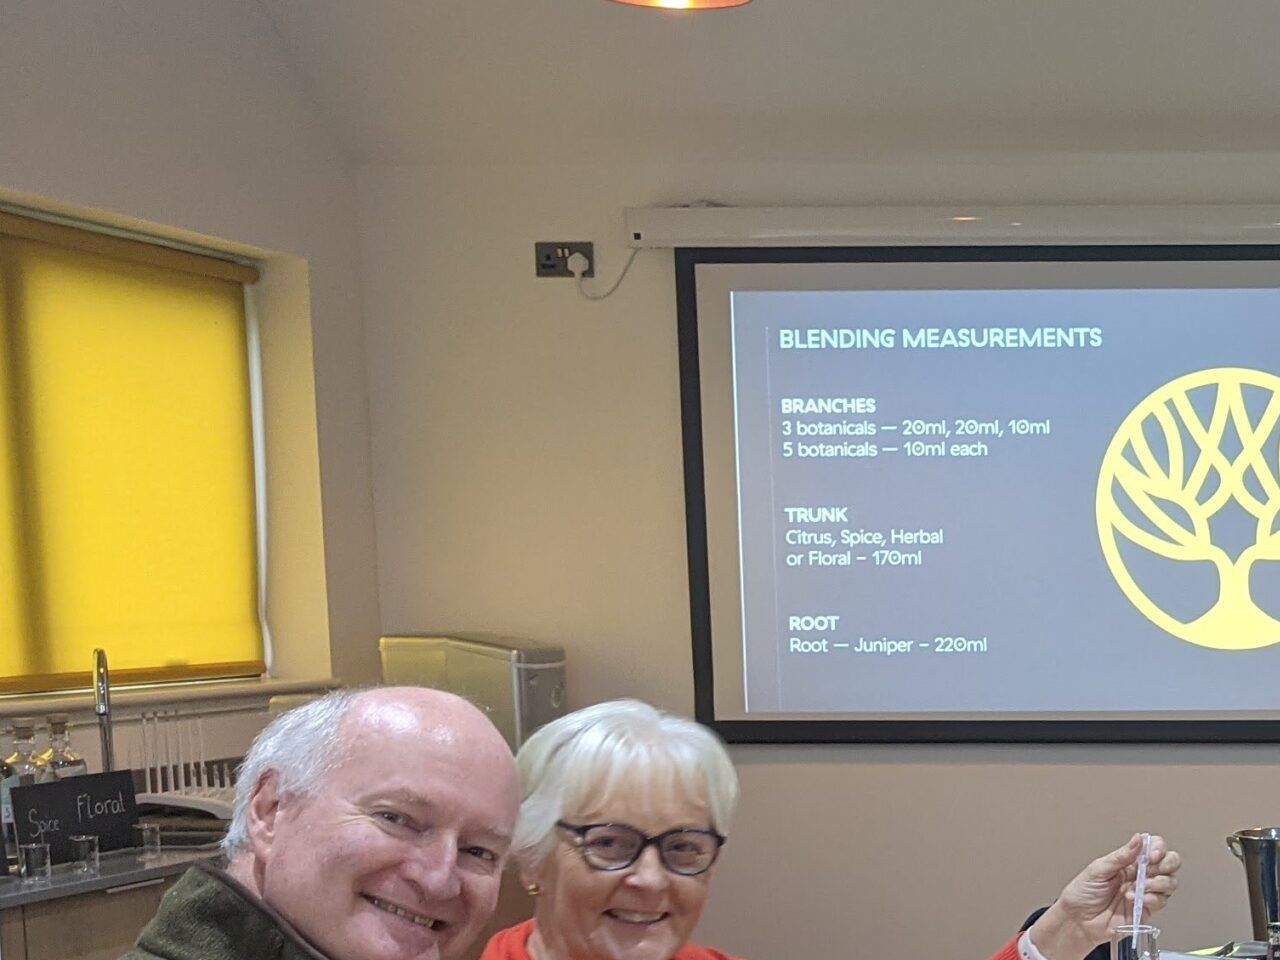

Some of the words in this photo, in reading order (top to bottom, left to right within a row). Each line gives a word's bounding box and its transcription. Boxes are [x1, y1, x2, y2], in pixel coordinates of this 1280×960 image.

[779, 328, 896, 349] BLENDING
[903, 327, 1103, 348] MEASUREMENTS
[781, 398, 876, 414] BRANCHES
[782, 420, 792, 436] 3
[796, 420, 876, 436] botanicals
[902, 420, 951, 438] 20ml,
[955, 420, 1003, 438] 20ml,
[1008, 419, 1050, 435] 10ml
[783, 442, 793, 457] 5
[797, 441, 877, 457] botanicals
[903, 441, 945, 457] 10ml
[950, 441, 988, 457] each
[784, 507, 848, 523] TRUNK
[785, 529, 837, 547] Citrus,
[841, 529, 888, 547] Spice,
[891, 528, 943, 544] Herbal
[786, 552, 804, 566] or
[809, 550, 850, 566] Floral
[872, 550, 922, 566] 170ml
[789, 616, 840, 631] ROOT
[789, 637, 829, 653] Root
[854, 637, 913, 656] Juniper
[934, 637, 988, 653] 220ml
[77, 792, 126, 823] Floral
[28, 808, 60, 843] Spice
